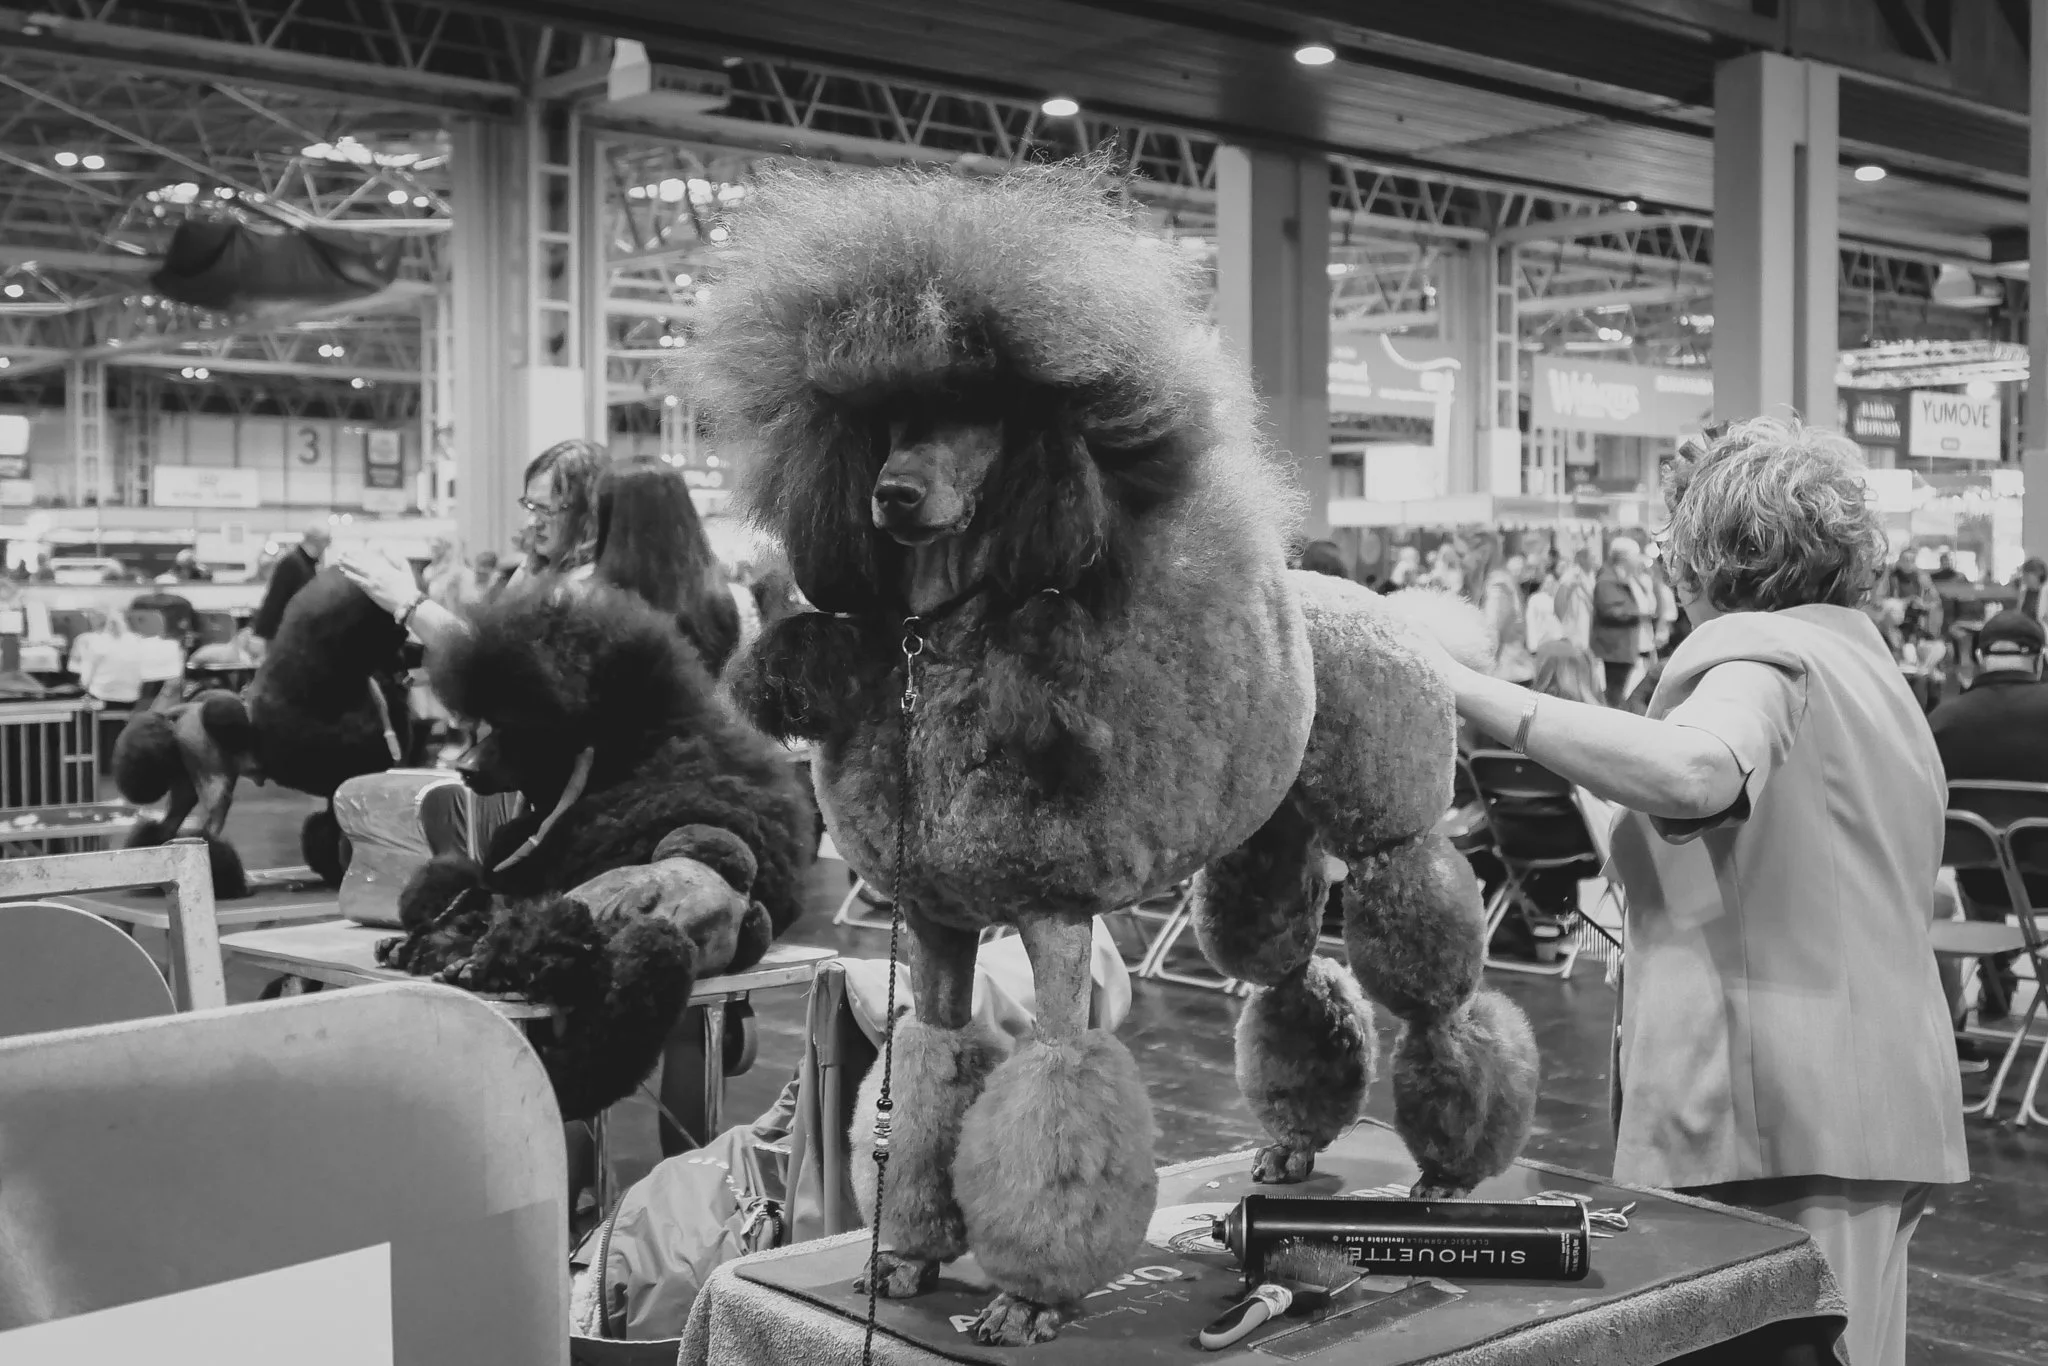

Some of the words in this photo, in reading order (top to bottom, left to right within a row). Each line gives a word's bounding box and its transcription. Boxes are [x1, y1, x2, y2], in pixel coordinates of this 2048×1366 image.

[1923, 399, 1991, 428] YUMOVE
[298, 427, 320, 464] 3
[1406, 1237, 1447, 1245] FORMULA
[1451, 1238, 1489, 1246] CLASSIC
[1348, 1247, 1526, 1265] SILHOUETTE
